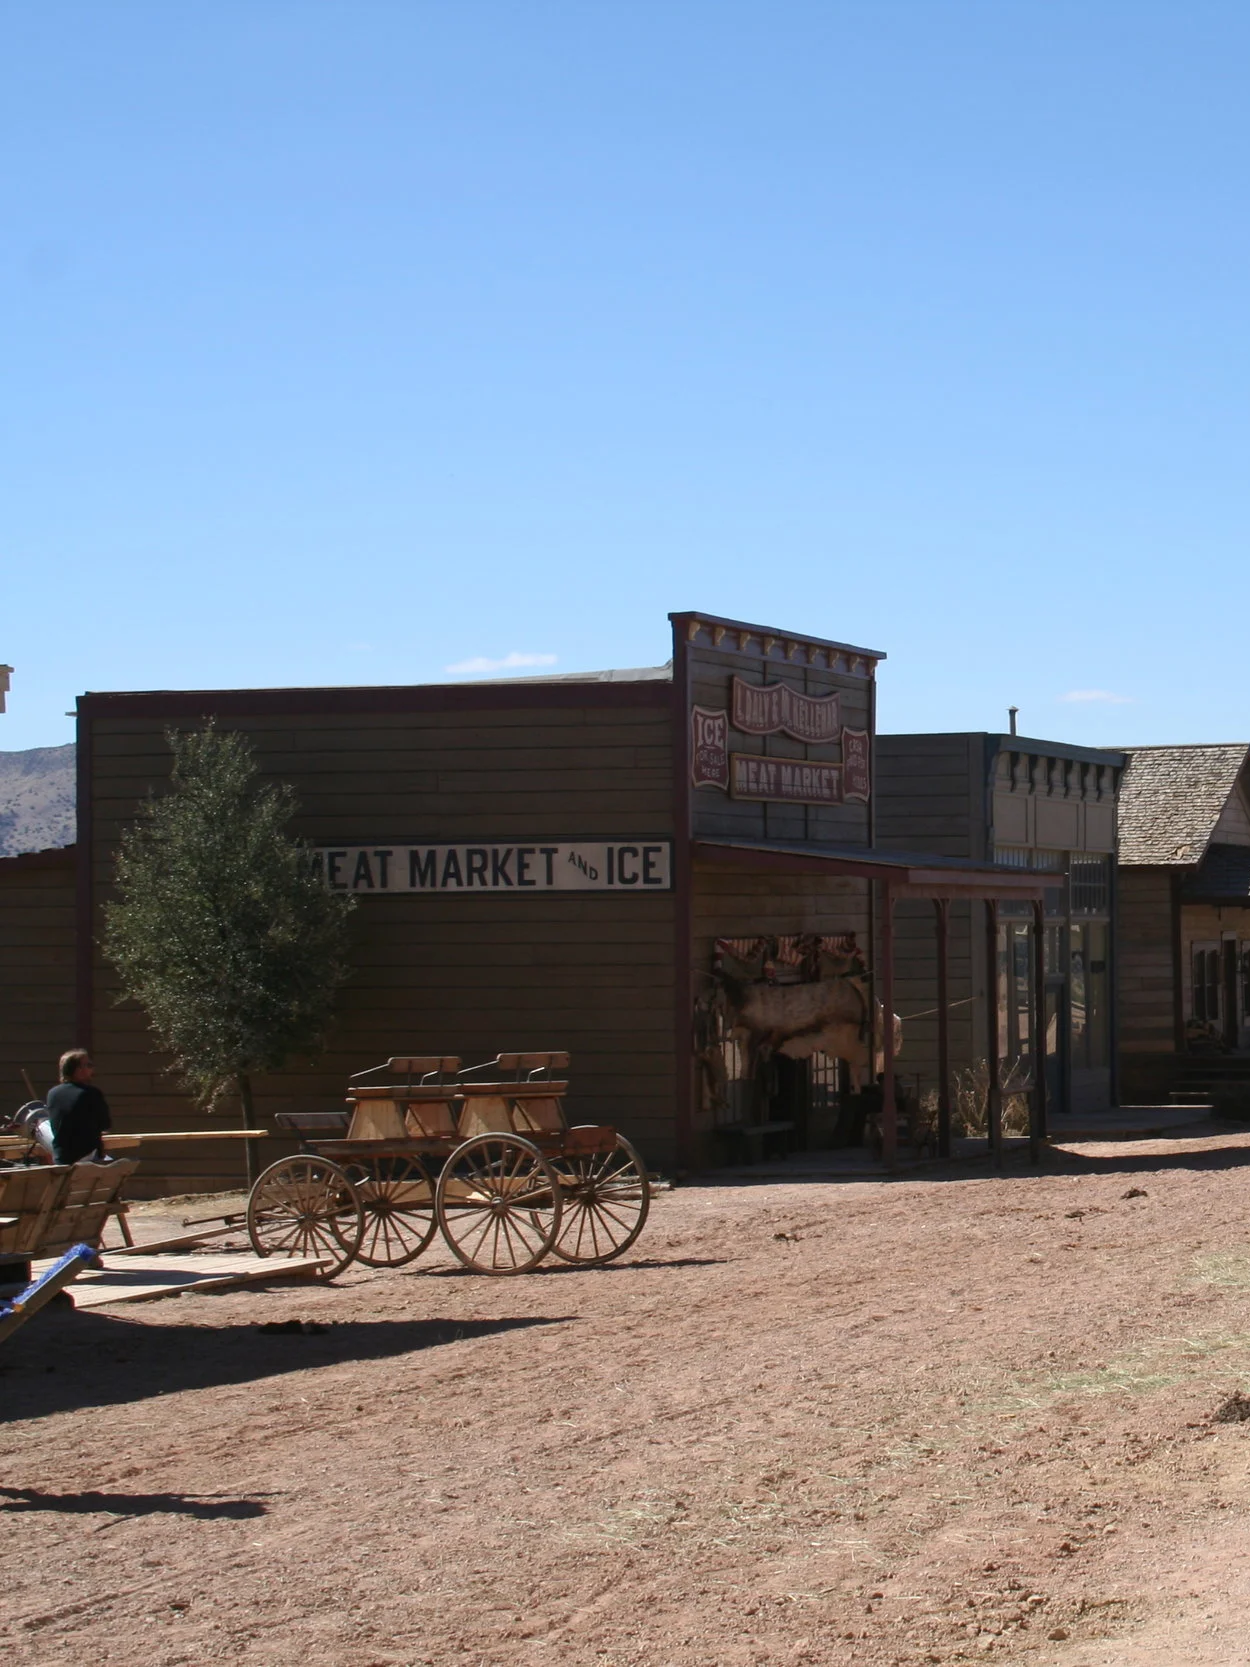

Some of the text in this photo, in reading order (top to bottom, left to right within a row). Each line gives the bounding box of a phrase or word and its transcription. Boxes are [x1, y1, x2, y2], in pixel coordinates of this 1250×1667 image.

[696, 714, 724, 750] ICE
[701, 764, 721, 778] HERE
[709, 751, 726, 767] SALE
[735, 759, 840, 799] MEAT MARKET
[409, 847, 558, 887] MARKET
[567, 851, 599, 881] AND
[607, 846, 663, 885] ICE
